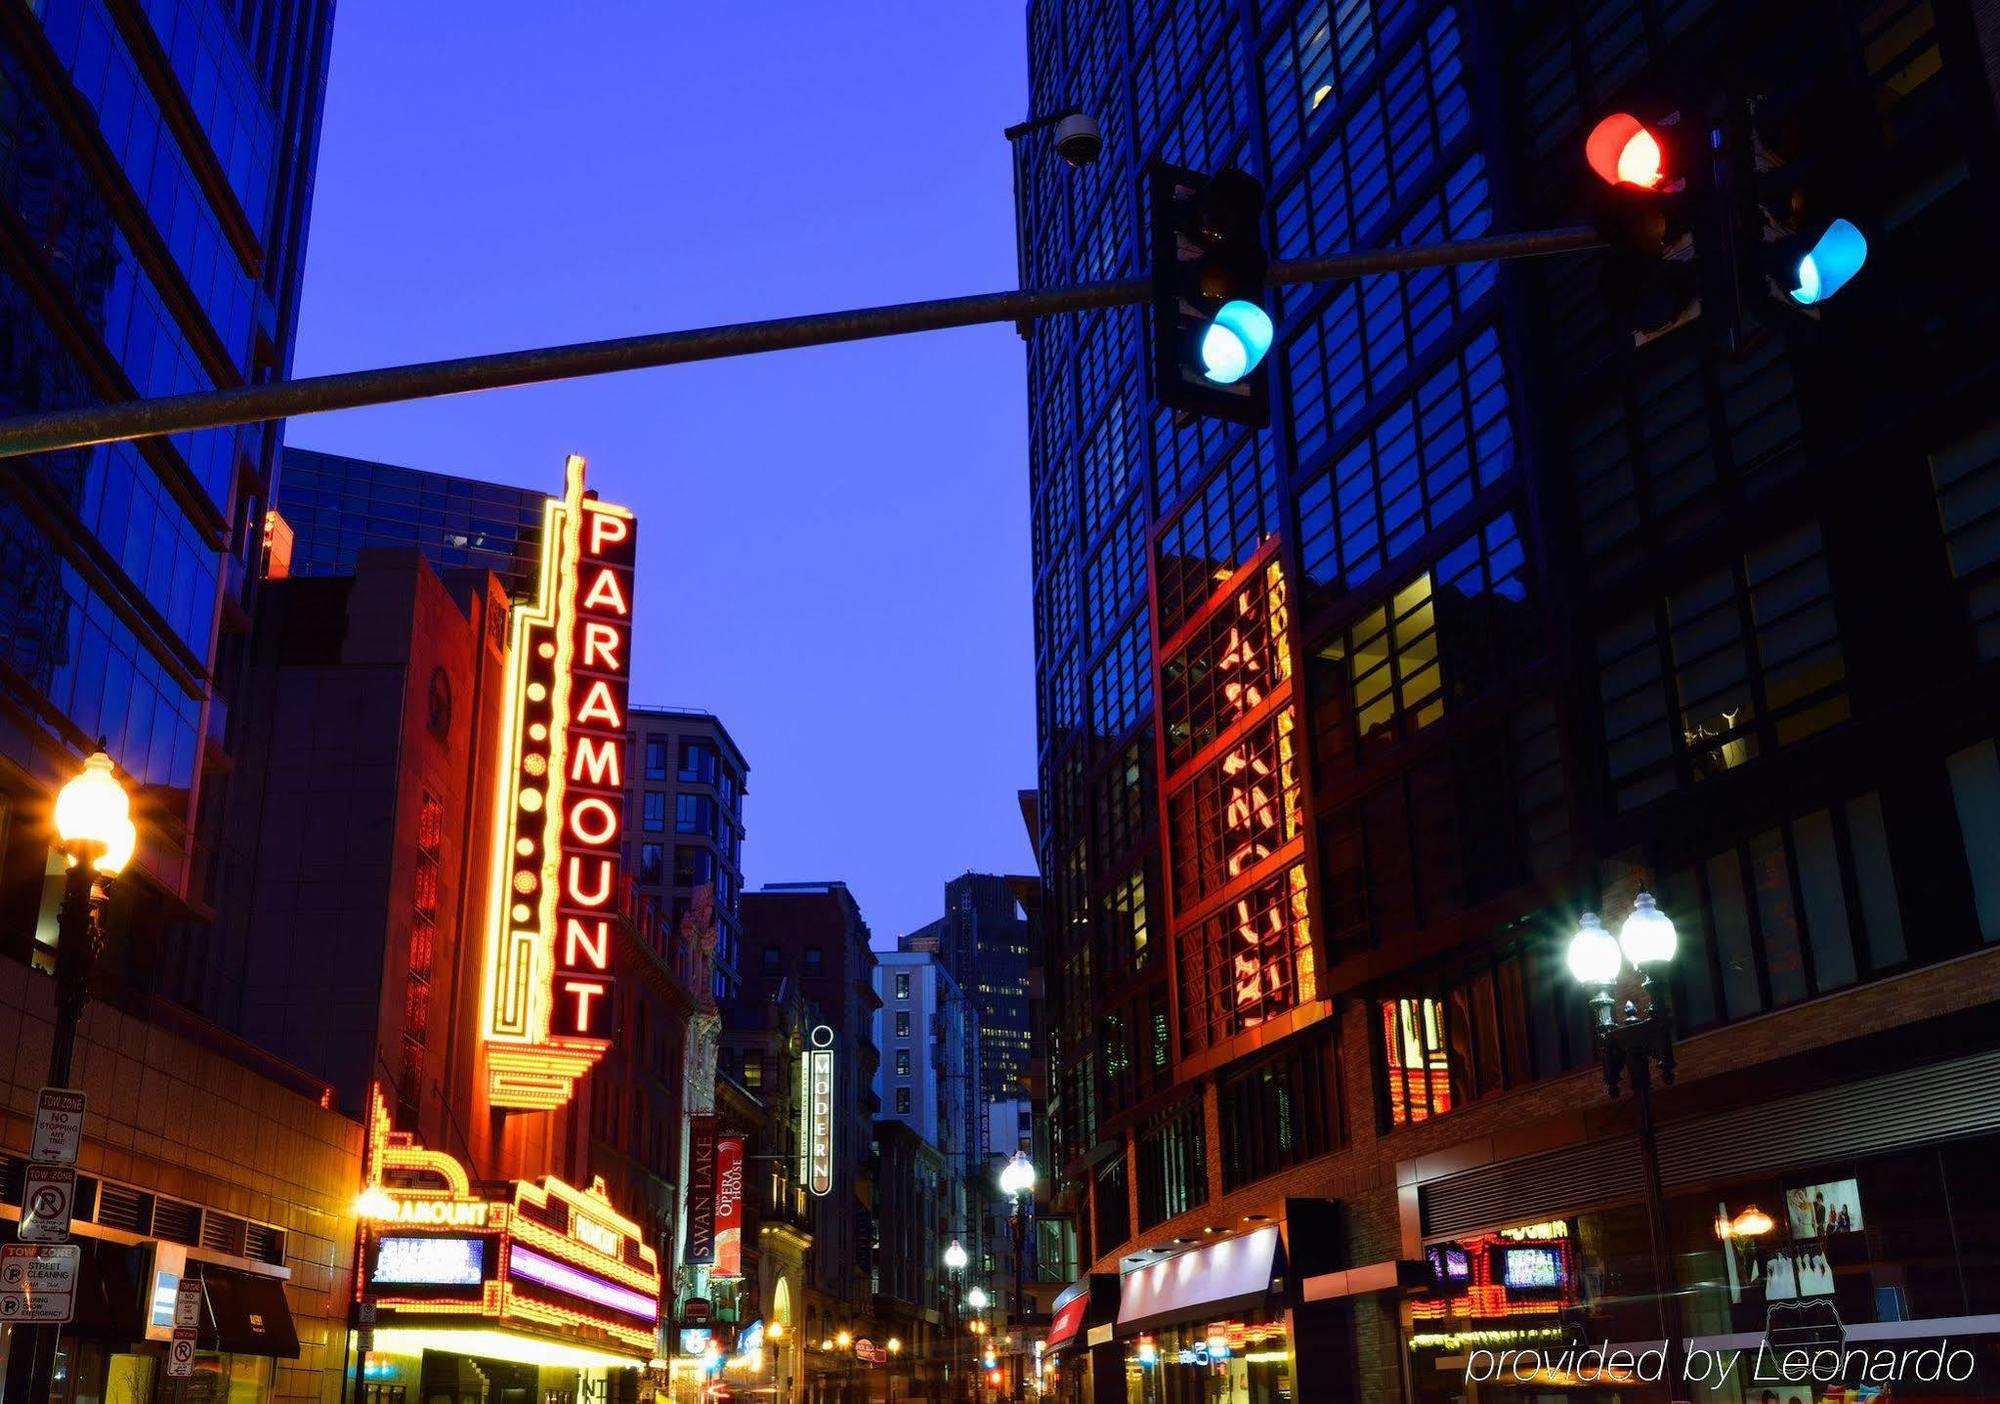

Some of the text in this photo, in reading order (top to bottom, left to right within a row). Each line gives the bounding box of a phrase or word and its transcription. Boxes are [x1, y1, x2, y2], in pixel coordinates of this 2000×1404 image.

[564, 512, 628, 1032] PARAMOUNT
[43, 1095, 82, 1110] TOW ZONE
[51, 1113, 68, 1123] NO
[814, 1060, 828, 1177] MODERN
[40, 1121, 77, 1132] STOPPING
[30, 1168, 73, 1180] TOW ZONE
[732, 1160, 742, 1200] HOUSE
[693, 1137, 712, 1257] SWAN LAKE
[720, 1169, 733, 1217] OPERA
[362, 1199, 488, 1225] RAMOUNT
[9, 1247, 73, 1257] TOW ZONE
[28, 1262, 61, 1271] STREET
[27, 1271, 69, 1279] CLEANING
